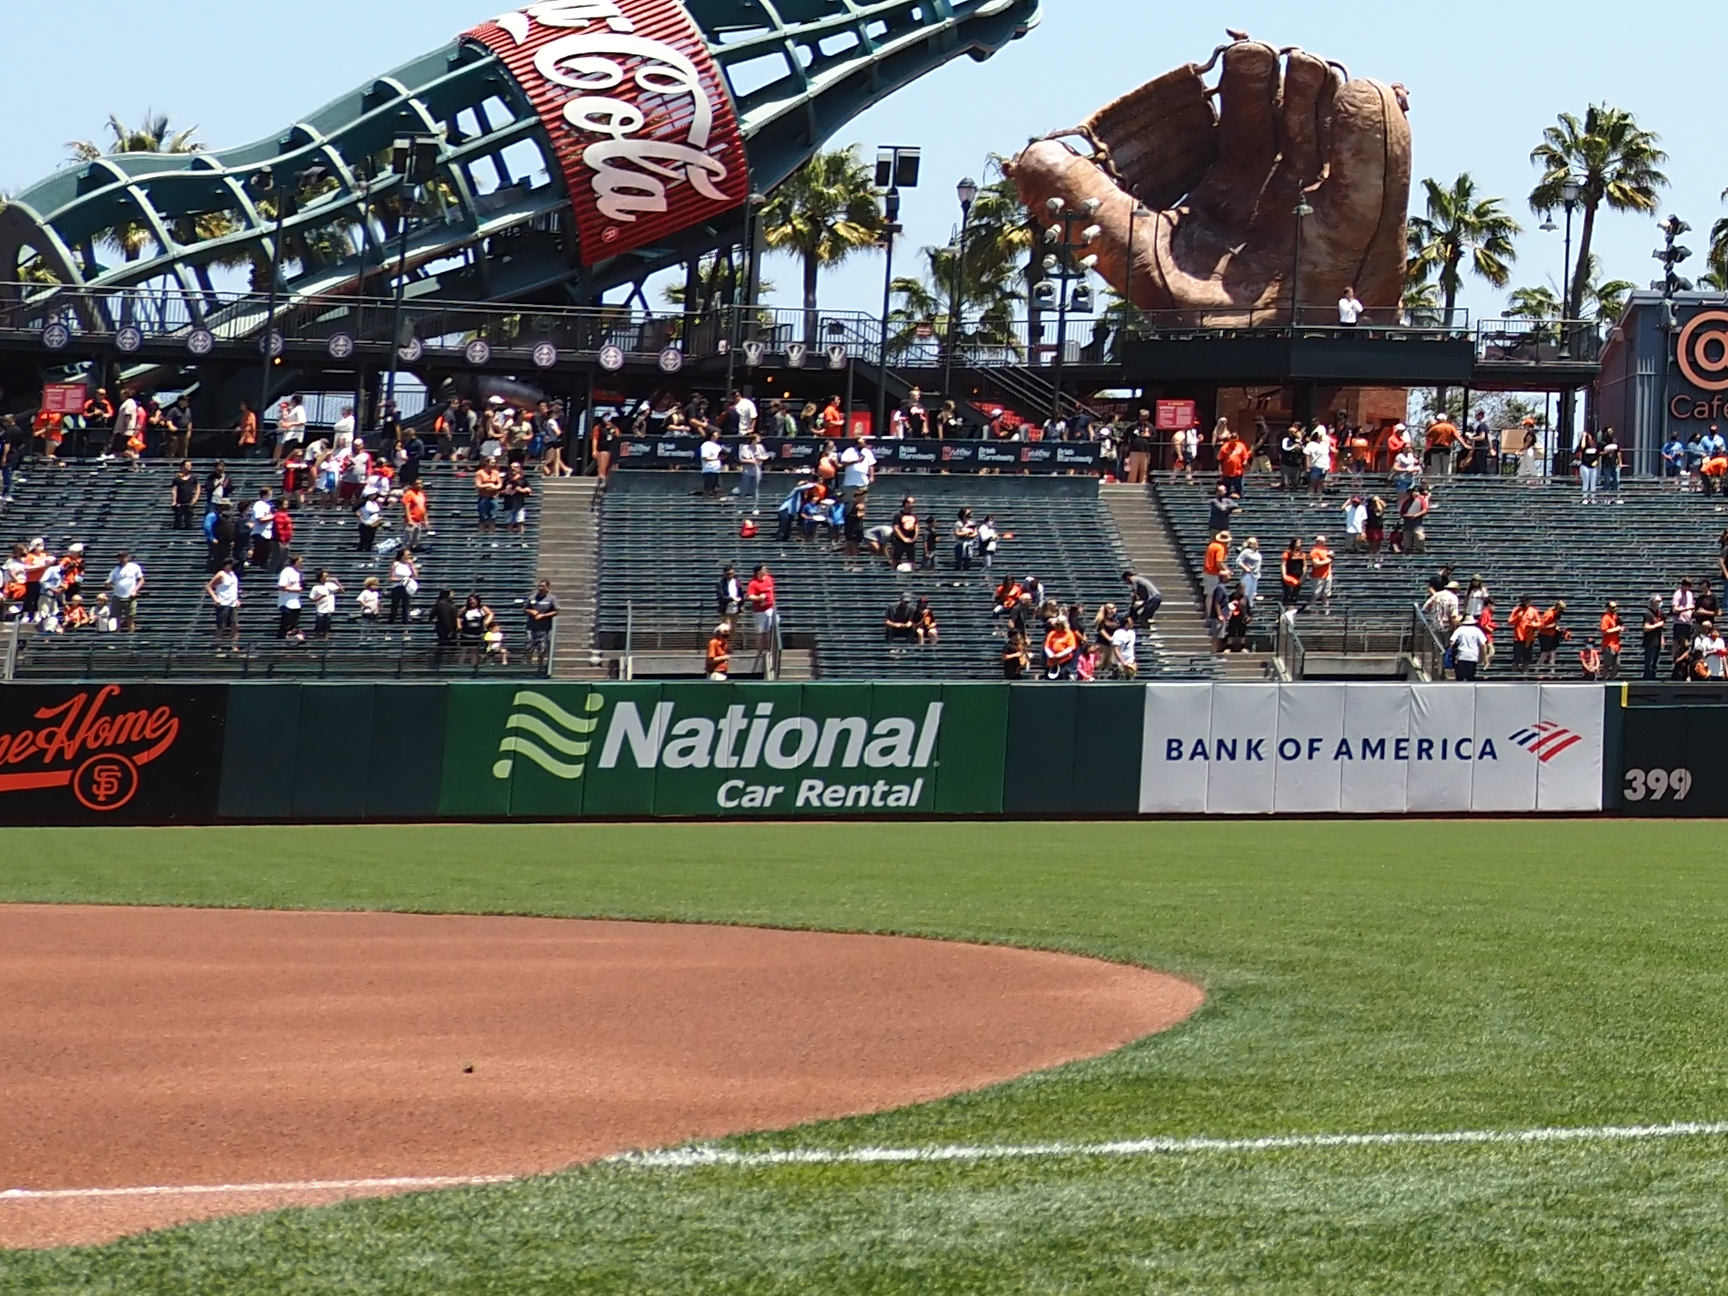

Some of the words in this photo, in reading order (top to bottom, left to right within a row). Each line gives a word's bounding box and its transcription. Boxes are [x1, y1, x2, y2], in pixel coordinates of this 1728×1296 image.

[34, 684, 180, 766] Home
[598, 701, 944, 769] National
[1165, 737, 1267, 762] BANK
[1278, 737, 1323, 761] OF
[1333, 736, 1499, 761] AMERICA
[716, 779, 786, 808] Car
[795, 778, 925, 808] Rental
[1623, 768, 1692, 801] 399
